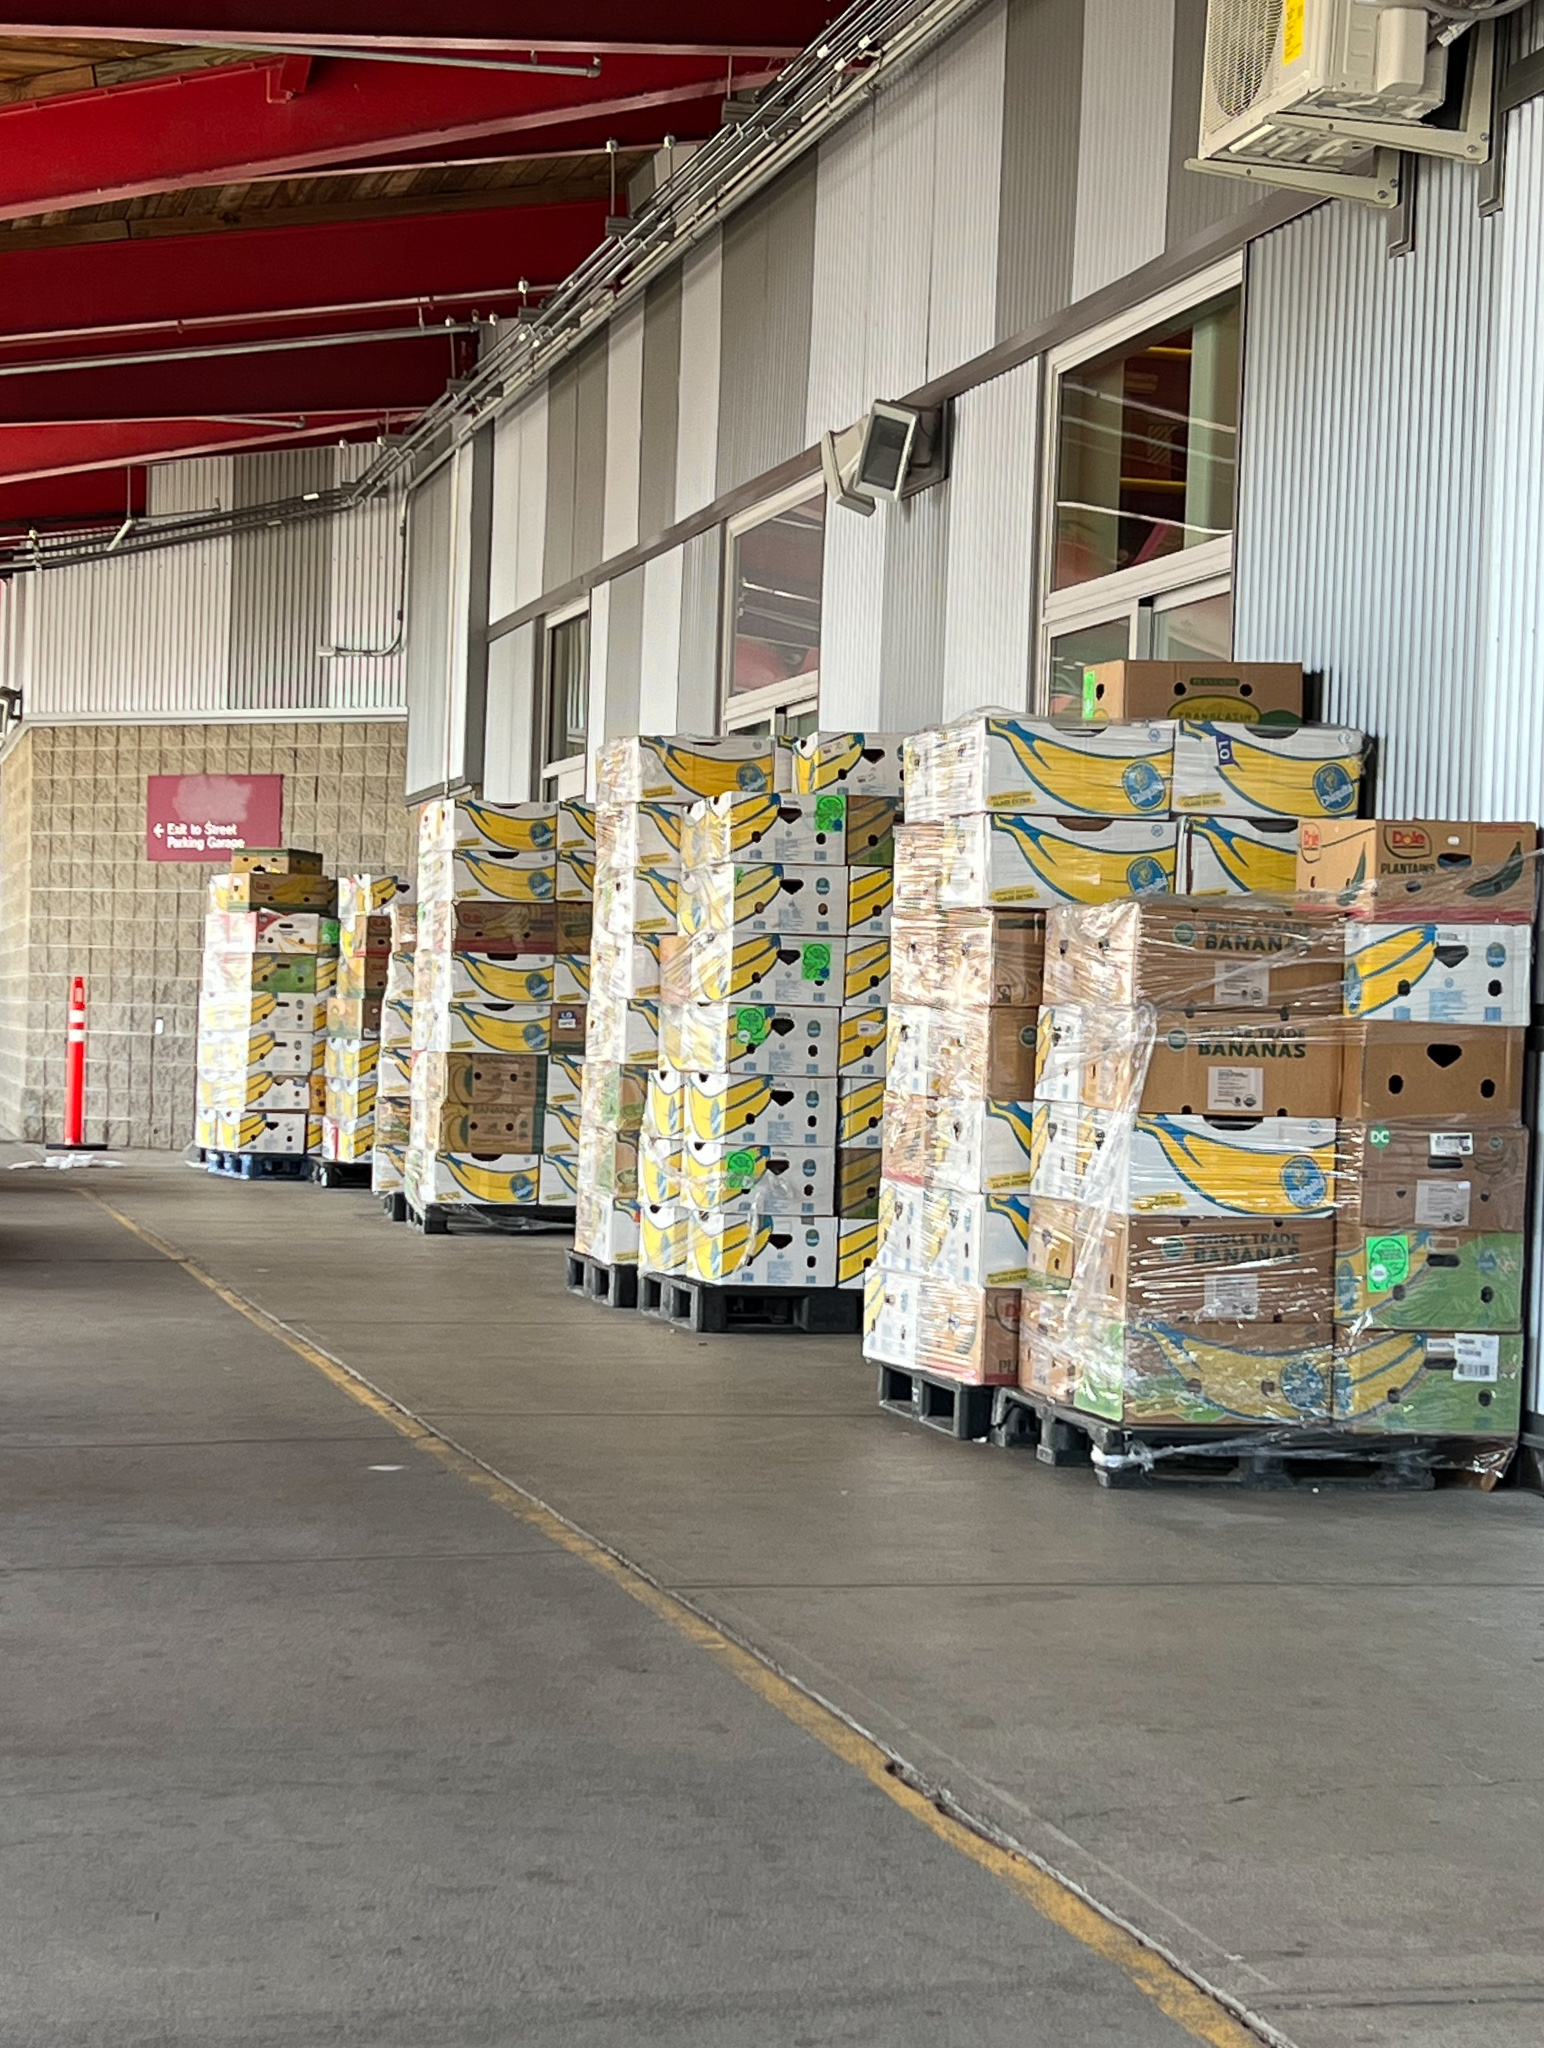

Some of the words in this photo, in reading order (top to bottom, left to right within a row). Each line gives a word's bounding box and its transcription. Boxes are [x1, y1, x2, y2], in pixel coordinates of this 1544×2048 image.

[166, 822, 188, 836] Exit
[189, 823, 203, 836] to
[204, 820, 238, 836] Street
[166, 836, 206, 852] Parking
[206, 836, 246, 850] Garage
[1392, 830, 1426, 846] Dole
[1380, 862, 1437, 876] PLANTAINS
[1197, 1040, 1307, 1059] BANANAS
[1369, 1129, 1390, 1144] DC
